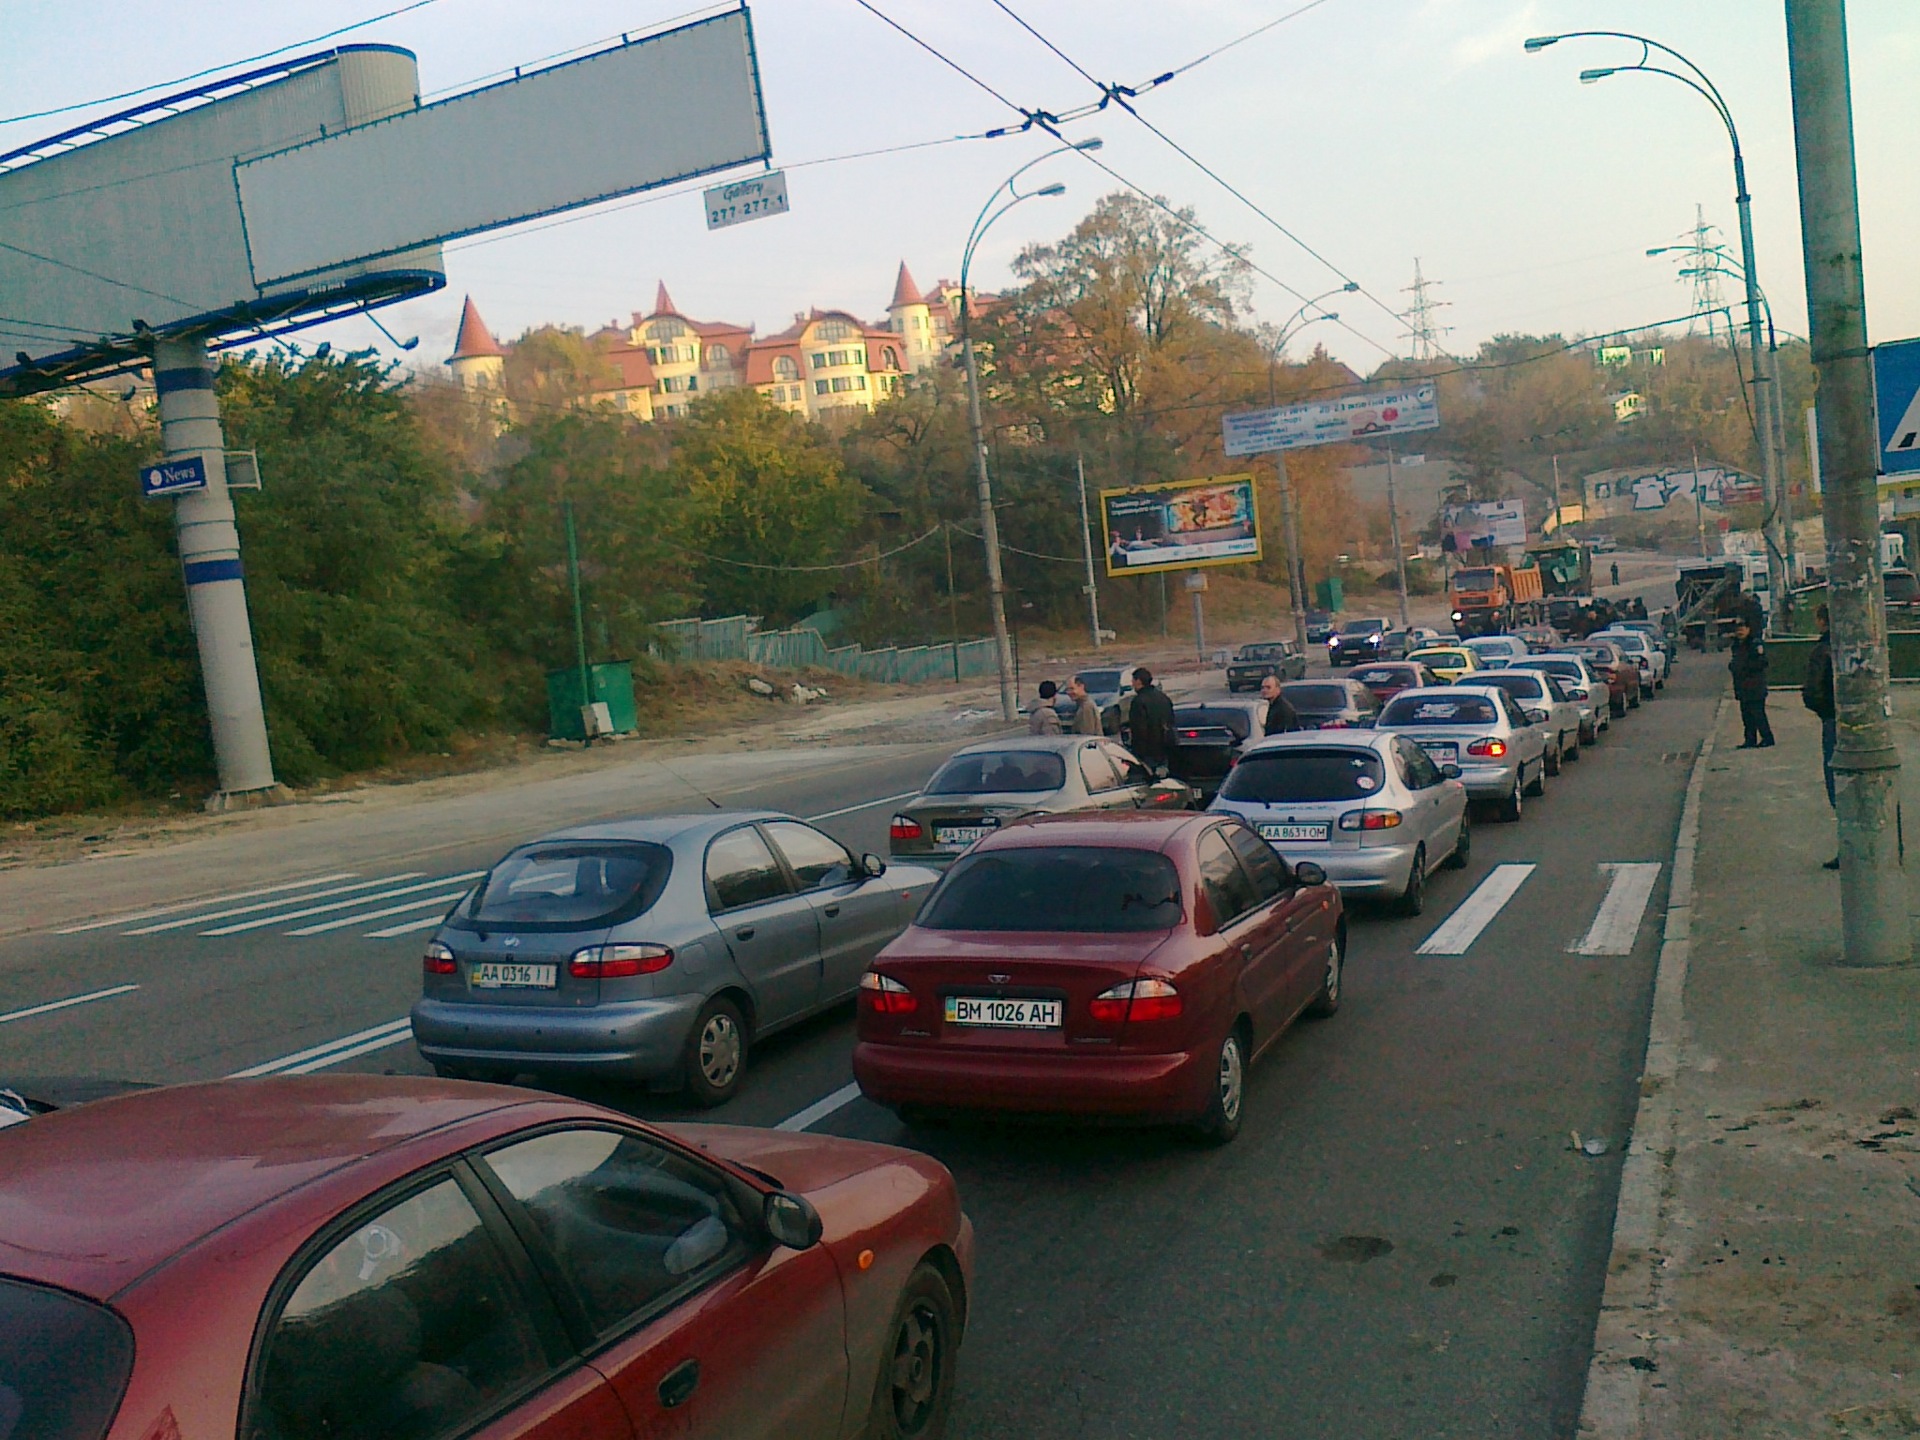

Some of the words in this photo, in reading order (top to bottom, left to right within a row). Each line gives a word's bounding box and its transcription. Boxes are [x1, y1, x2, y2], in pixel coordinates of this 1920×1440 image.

[163, 466, 196, 483] News
[1265, 827, 1280, 838] AA
[1309, 827, 1325, 838] OM
[481, 965, 499, 981] AA
[502, 966, 531, 982] 0316
[957, 1001, 982, 1020] BM
[986, 1003, 1025, 1021] 1026
[1029, 1004, 1055, 1022] AH
